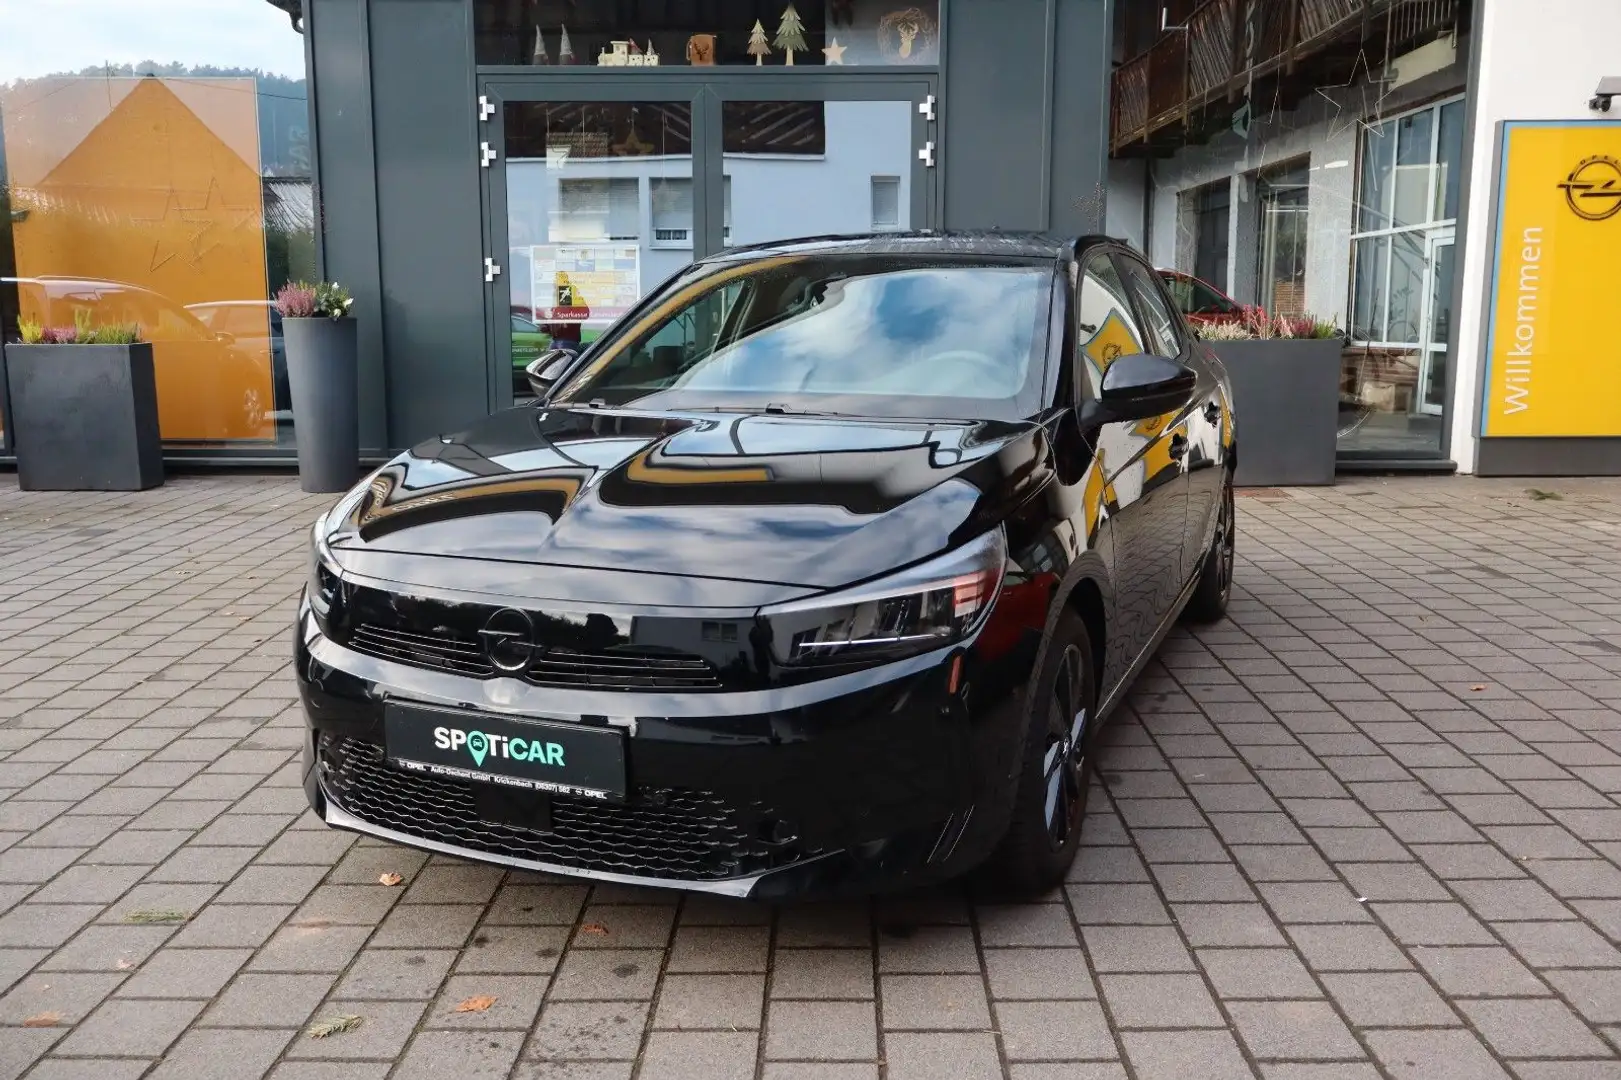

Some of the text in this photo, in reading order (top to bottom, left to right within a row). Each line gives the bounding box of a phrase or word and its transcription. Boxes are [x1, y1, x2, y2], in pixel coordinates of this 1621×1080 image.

[557, 311, 588, 319] Sparkasse
[1504, 226, 1543, 415] Willkommen
[407, 762, 426, 772] OPEL
[471, 772, 491, 782] GmbH
[584, 789, 607, 799] OPEL
